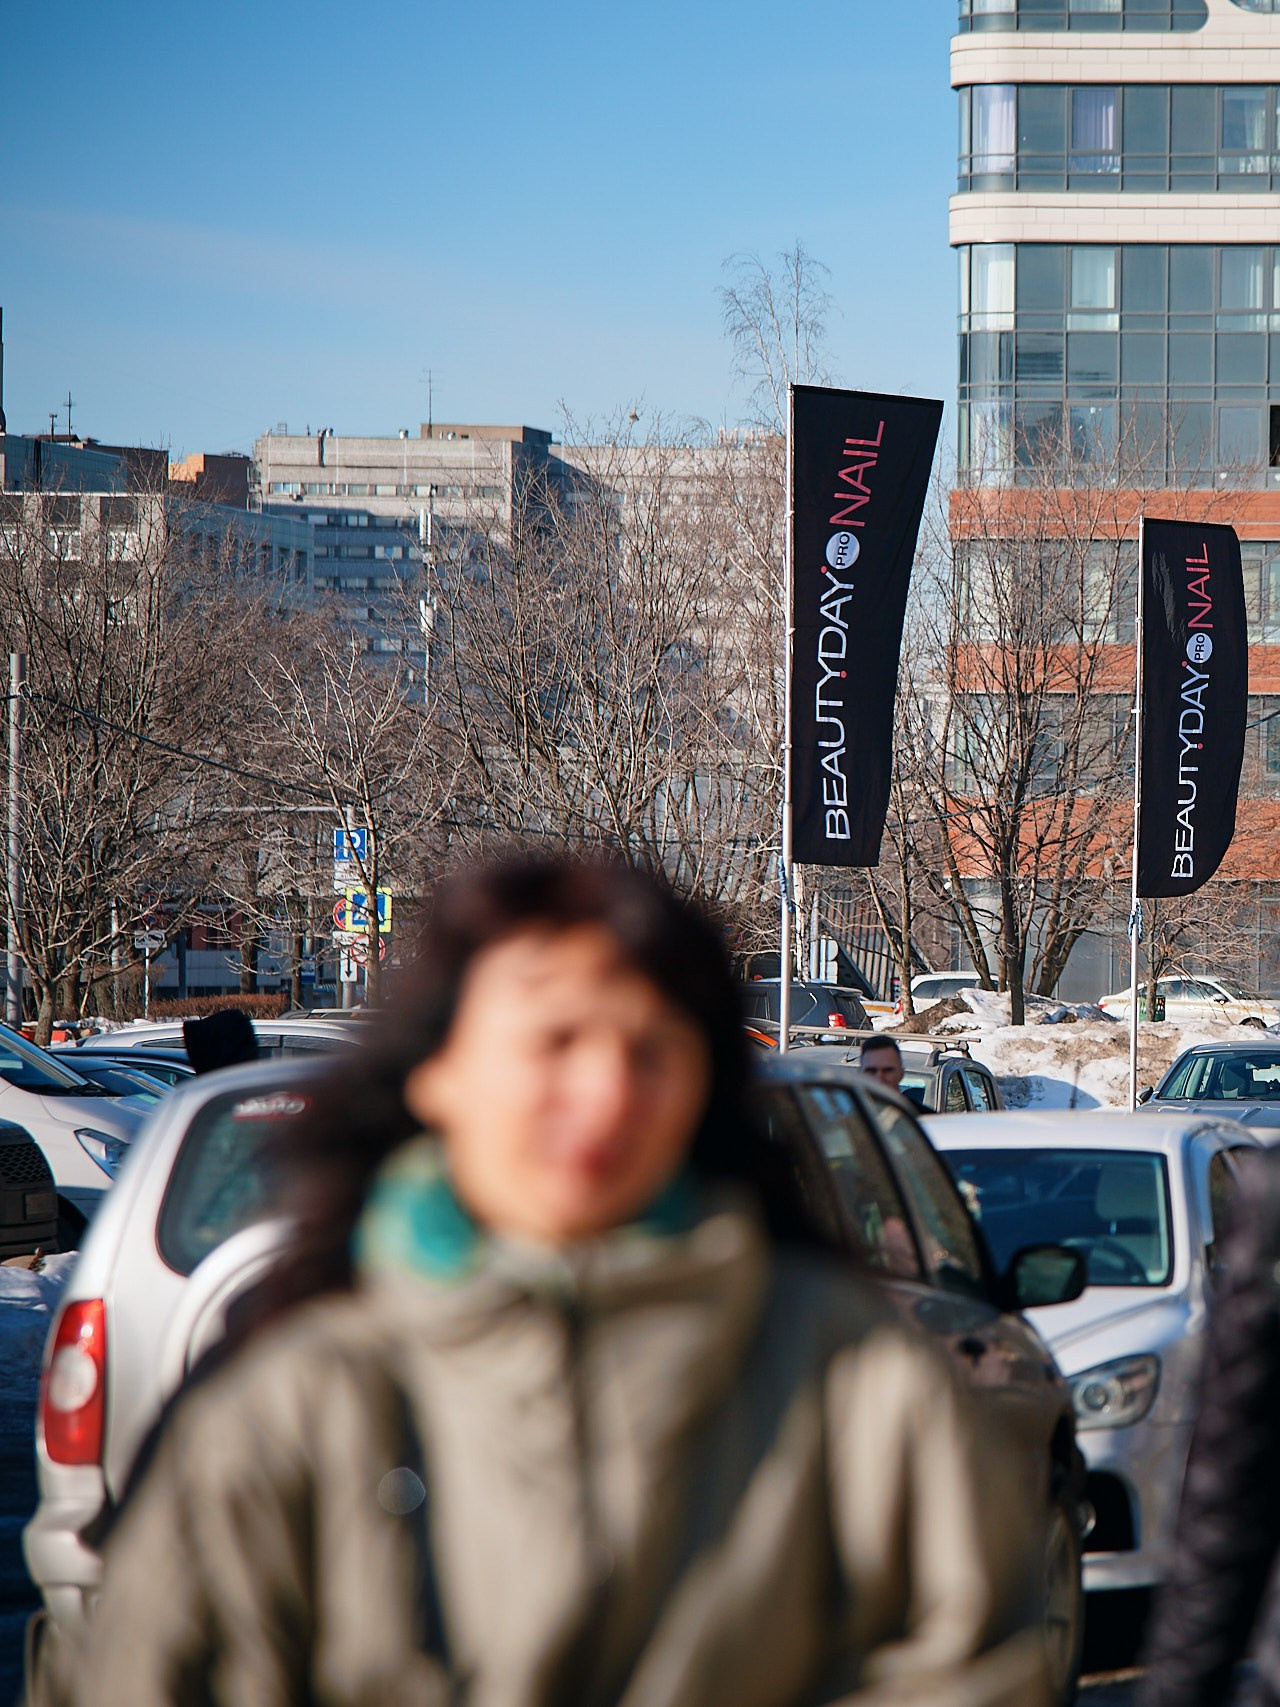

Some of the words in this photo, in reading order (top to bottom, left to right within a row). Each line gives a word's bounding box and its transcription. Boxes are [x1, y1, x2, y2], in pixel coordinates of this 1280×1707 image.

[829, 420, 885, 527] NAIL
[836, 533, 851, 566] PRO
[1185, 542, 1214, 629] NAIL
[1194, 634, 1205, 661] PRO
[815, 567, 854, 840] BEAUTYDAY
[1171, 660, 1210, 878] BEAUTYDAY
